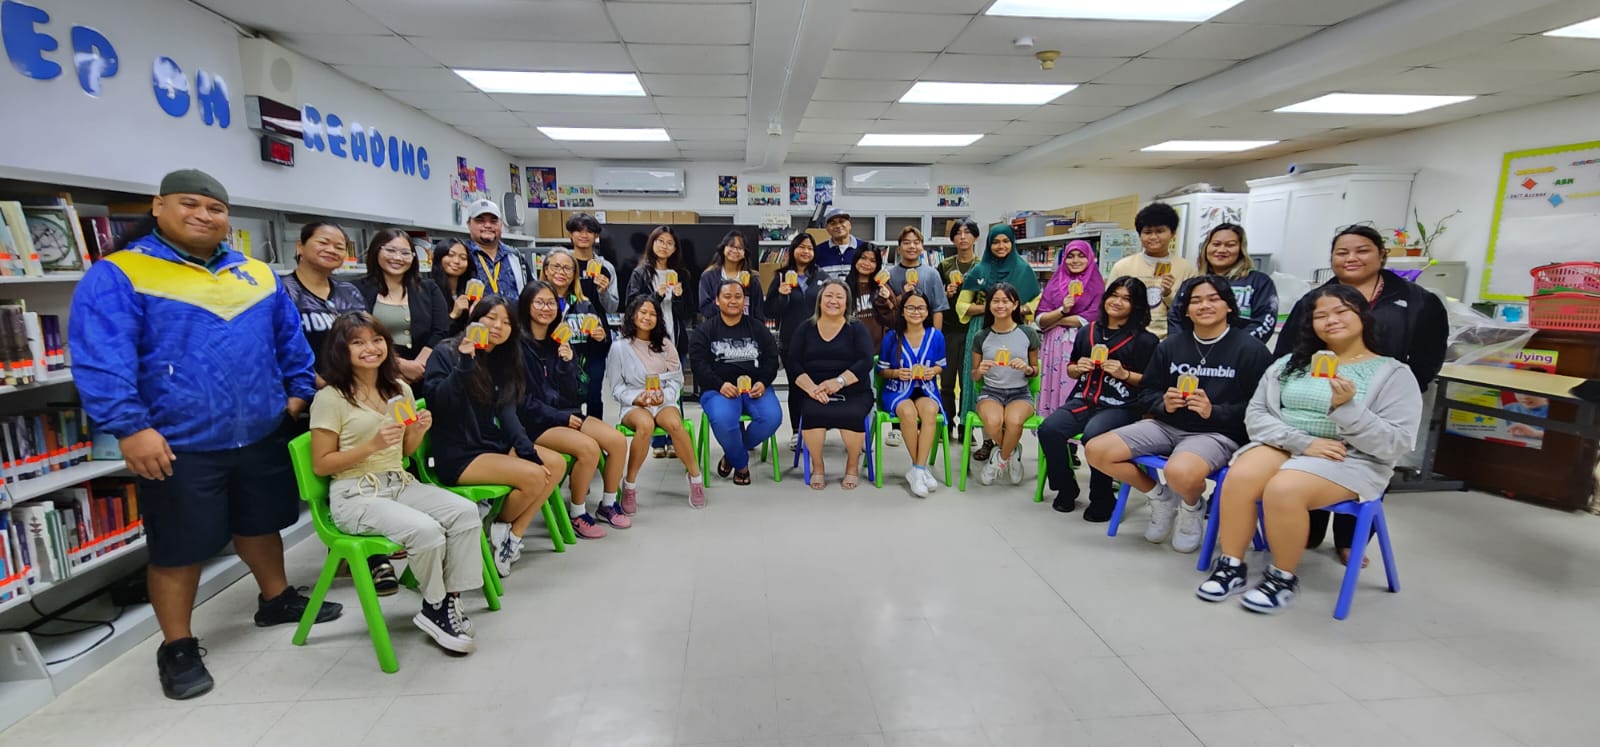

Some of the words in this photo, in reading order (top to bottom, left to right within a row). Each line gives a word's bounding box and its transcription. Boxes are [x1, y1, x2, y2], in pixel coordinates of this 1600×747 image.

[152, 55, 231, 129] ON
[300, 103, 431, 181] READING
[1178, 363, 1236, 378] Columbia
[1103, 375, 1130, 398] COAST
